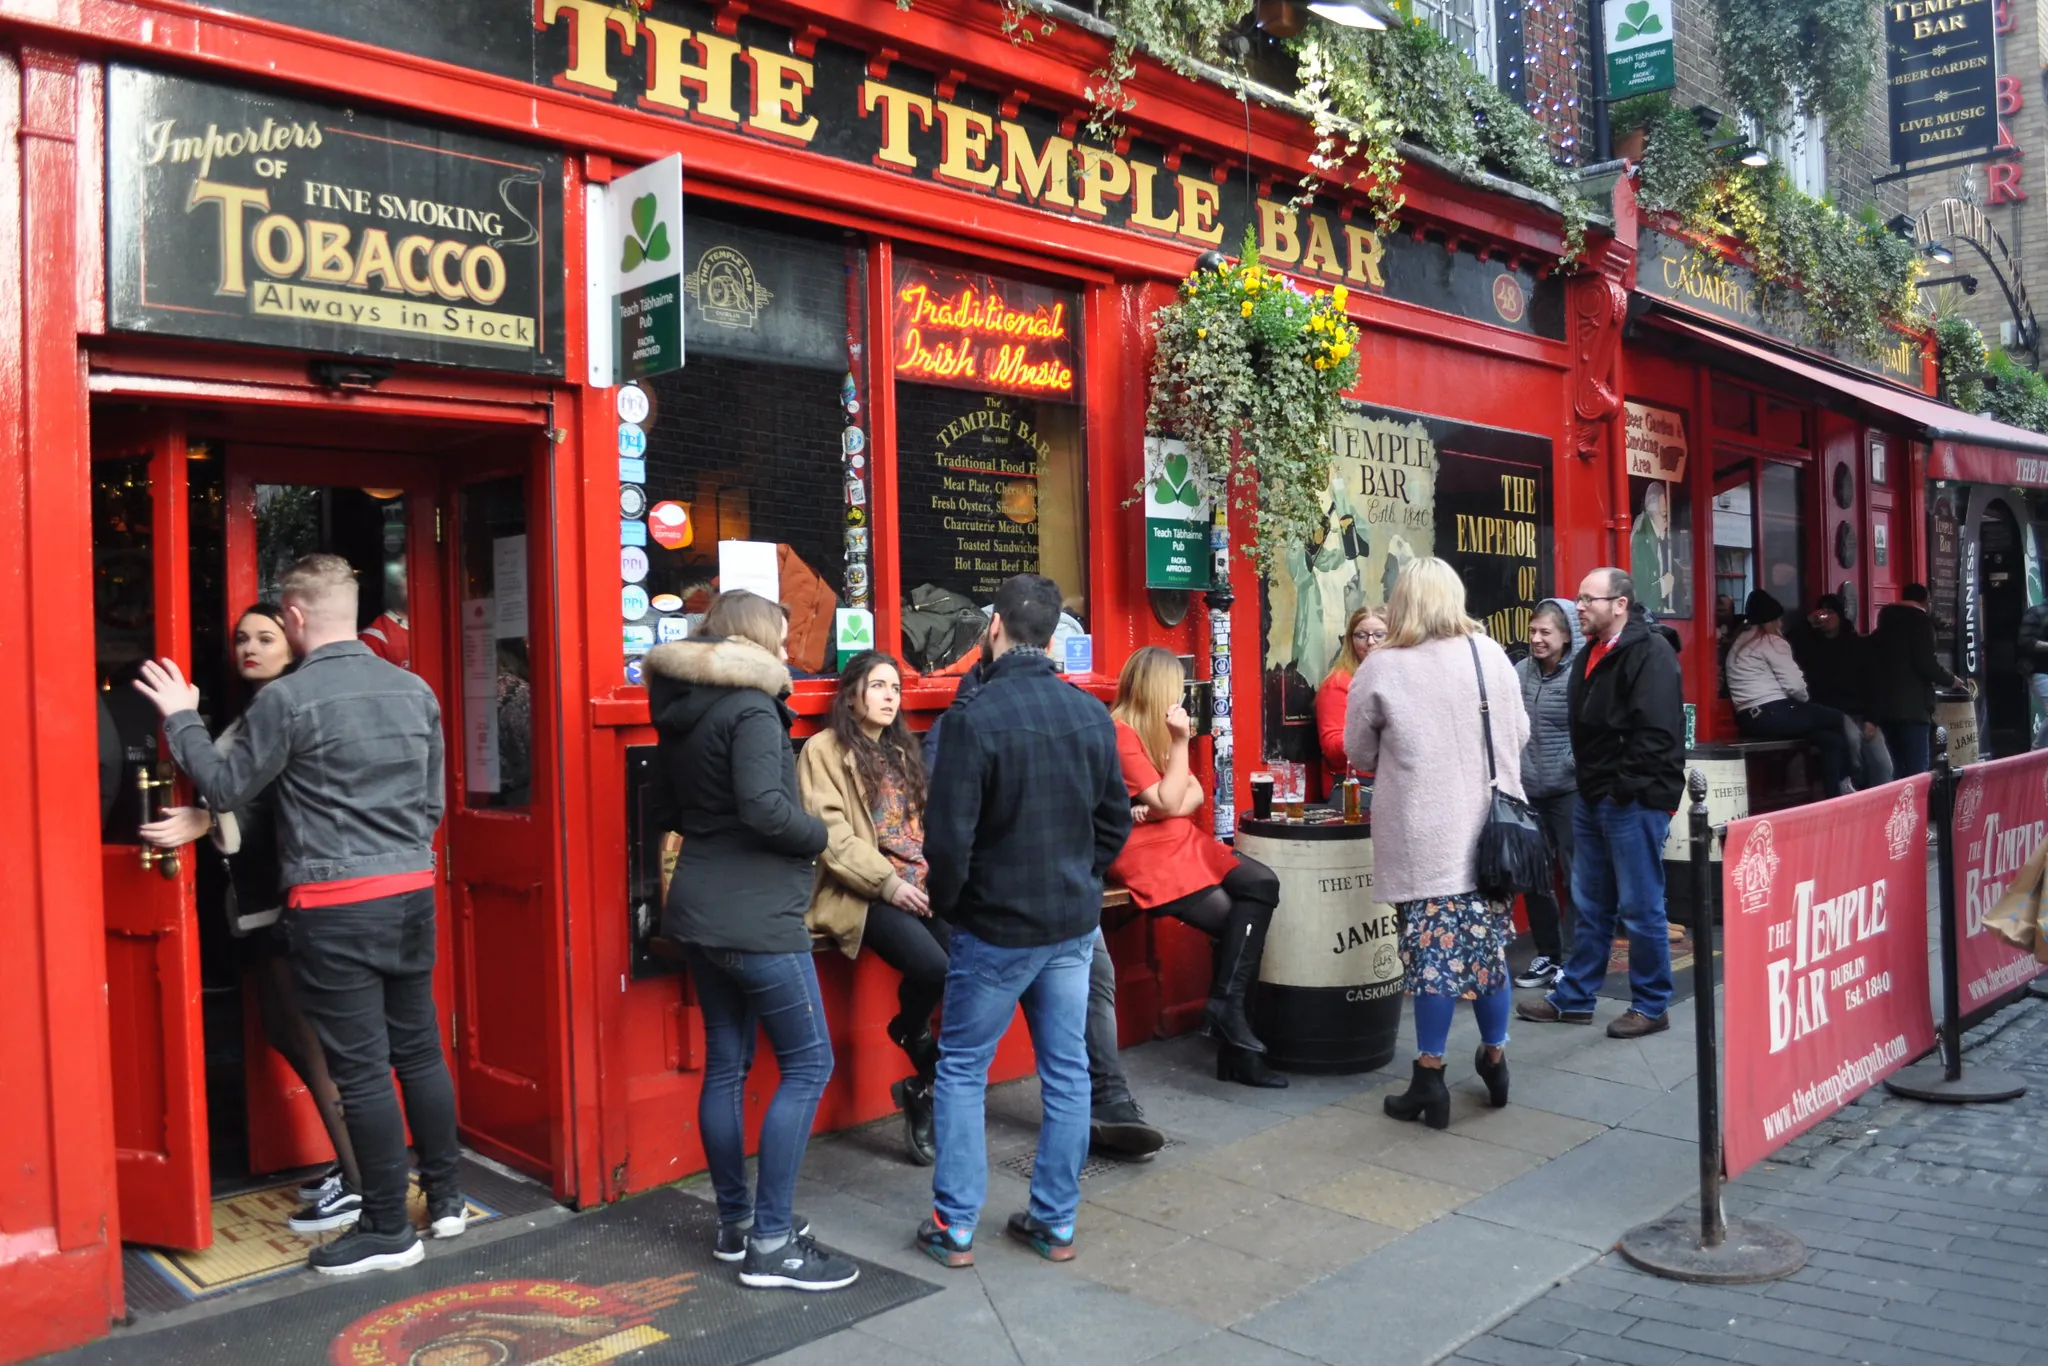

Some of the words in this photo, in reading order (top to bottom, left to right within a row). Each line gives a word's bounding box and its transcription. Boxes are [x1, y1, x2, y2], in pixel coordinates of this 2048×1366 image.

[1893, 0, 1983, 22] TEMP
[1913, 14, 1967, 40] BAR
[1615, 54, 1633, 66] Teach
[1634, 61, 1647, 69] Pub
[1895, 67, 1929, 86] BEER
[1931, 56, 1987, 77] GARDEN
[1628, 75, 1655, 86] APPROVED
[1900, 116, 1934, 133] LIVE
[1936, 105, 1986, 126] MUSIC
[537, 0, 819, 146] THE
[860, 78, 1225, 249] TEMPLE
[1257, 196, 1385, 291] BAR
[1919, 125, 1965, 144] DAILY
[138, 117, 323, 178] Importers
[254, 158, 288, 179] OF
[304, 180, 372, 216] FINE
[377, 194, 505, 237] SMOKING
[186, 178, 507, 306] TOBACCO
[701, 262, 711, 286] THE
[708, 250, 744, 267] TEMPLE
[742, 267, 753, 292] BAR
[1497, 281, 1516, 312] 48
[258, 282, 382, 323] Always
[401, 305, 428, 329] in
[441, 307, 530, 343] Stock
[619, 301, 639, 318] Teach
[639, 314, 653, 329] Pub
[901, 285, 1064, 338] Traditional
[632, 345, 661, 360] APPROVED
[896, 328, 976, 377] Irish
[989, 344, 1073, 390] Music
[985, 397, 1001, 408] The
[1624, 407, 1643, 430] Beer
[936, 410, 1011, 449] TEMPLE
[1017, 420, 1051, 461] BAR
[1329, 424, 1431, 469] TEMPLE
[1625, 429, 1659, 458] Smoking
[935, 452, 996, 471] Traditional
[1000, 459, 1025, 474] Food
[1632, 453, 1652, 474] Area
[2016, 457, 2037, 482] THE
[943, 476, 965, 491] Meat
[968, 478, 993, 495] Plate,
[1360, 464, 1410, 504] BAR
[1501, 474, 1536, 515] THE
[931, 495, 956, 510] Fresh
[959, 498, 993, 516] Oysters,
[655, 530, 681, 539] zomato
[943, 516, 995, 533] Charcuterie
[998, 521, 1025, 537] Meats,
[1153, 527, 1172, 538] Teach
[1456, 513, 1537, 559] EMPEROR
[957, 537, 991, 552] Toasted
[994, 540, 1040, 554] Sandwiches
[1172, 541, 1185, 551] Pub
[955, 557, 971, 570] Hot
[974, 558, 998, 572] Roast
[1001, 559, 1020, 573] Beef
[1166, 565, 1191, 573] APPROVED
[1517, 566, 1537, 601] OF
[1966, 541, 1977, 673] GUINNESS
[664, 625, 680, 635] tax
[1712, 787, 1733, 798] THE
[1968, 840, 1982, 863] THE
[1982, 812, 2046, 881] TEMPLE
[1319, 876, 1352, 893] THE
[1768, 919, 1792, 952] THE
[1792, 879, 1887, 971] TEMPLE
[1830, 955, 1865, 991] DUBLIN
[1845, 984, 1864, 1011] Est.
[1865, 970, 1890, 1001] 1840
[1767, 957, 1829, 1055] BAR
[1762, 1033, 1909, 1141] www.thetemplebarpub.com
[358, 1284, 519, 1337] TEMPLE
[526, 1284, 602, 1310] BAR
